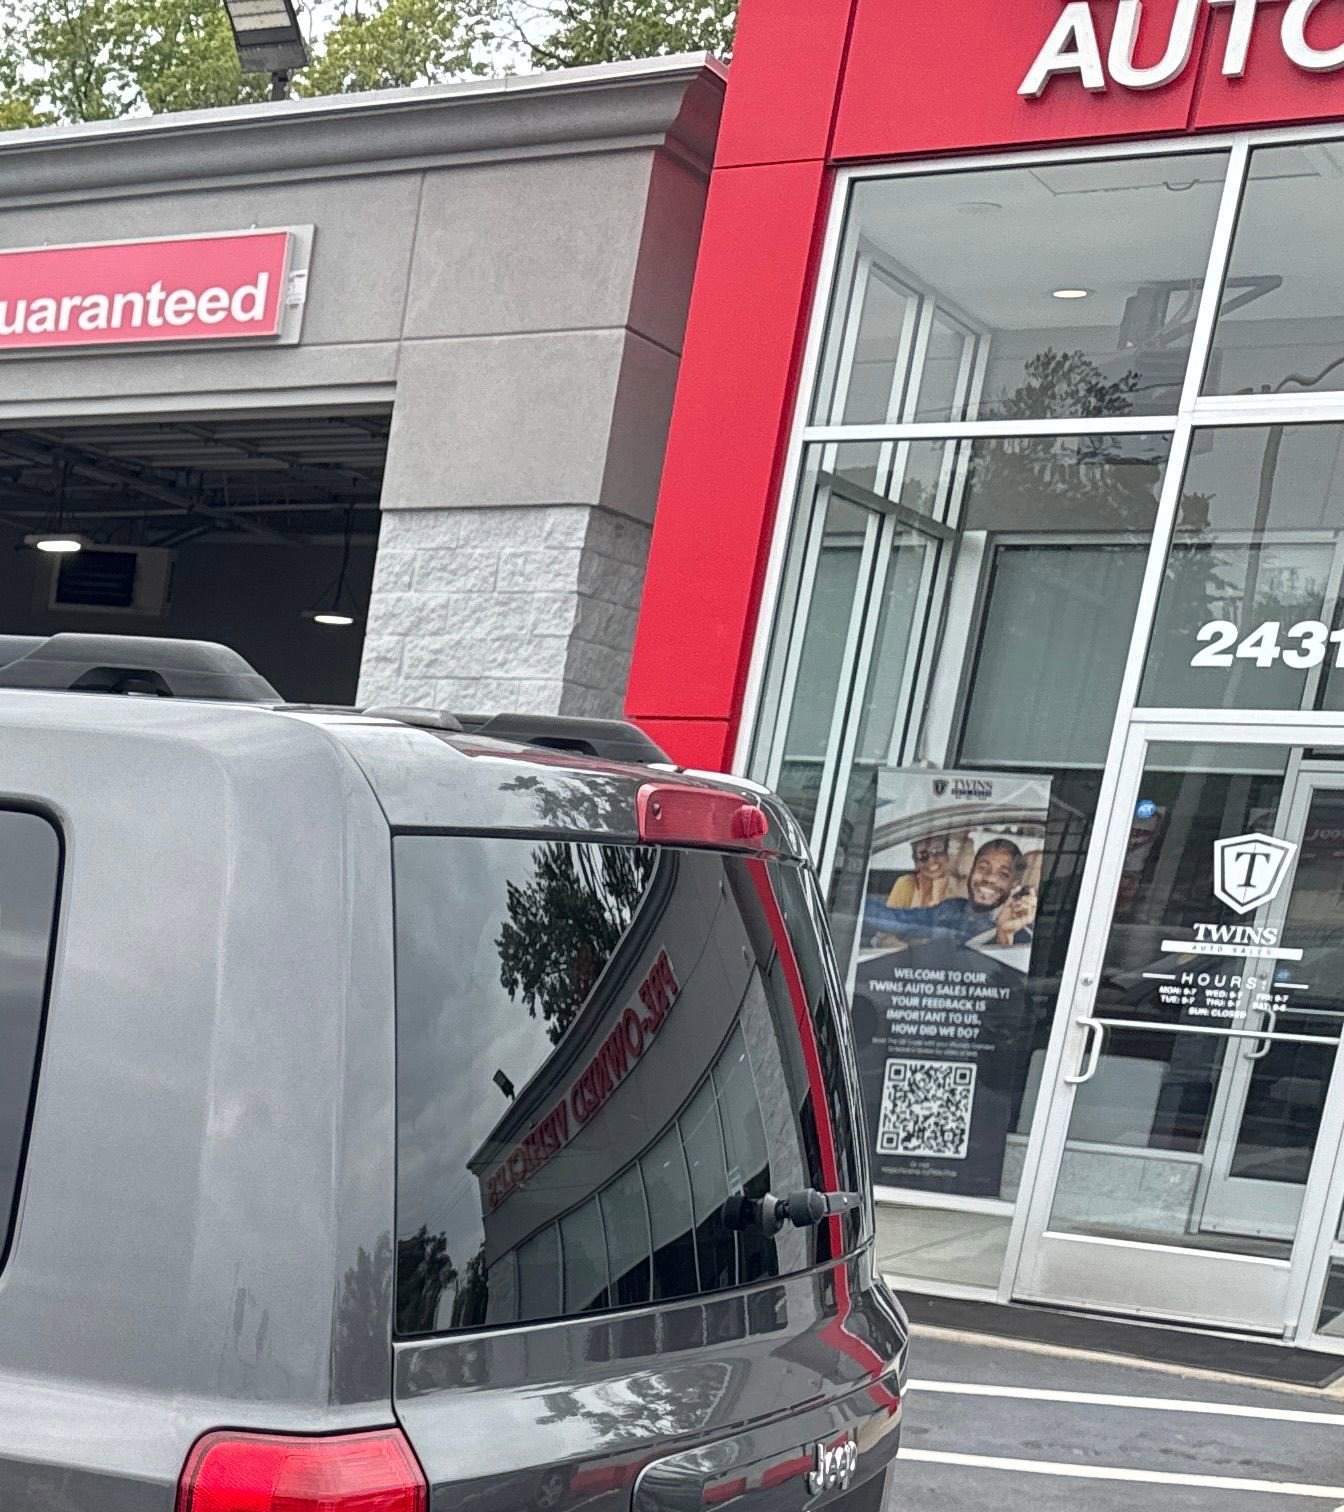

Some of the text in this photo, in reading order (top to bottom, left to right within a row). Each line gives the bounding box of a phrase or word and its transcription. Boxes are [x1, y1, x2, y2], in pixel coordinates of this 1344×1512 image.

[1235, 851, 1272, 888] T
[1192, 922, 1278, 945] TWINS
[894, 967, 987, 984] WELCOME TO OUR
[1181, 972, 1268, 991] HOURS:
[869, 980, 903, 993] TWINS
[904, 983, 934, 994] AUTO
[936, 985, 967, 997] SALES
[891, 996, 986, 1012] YOUR FEEDBACK IS
[886, 1009, 947, 1022] IMPORTANT
[948, 1012, 962, 1023] TO
[1211, 1009, 1247, 1019] CLOSED
[891, 1023, 980, 1039] HOW DID WE DO?
